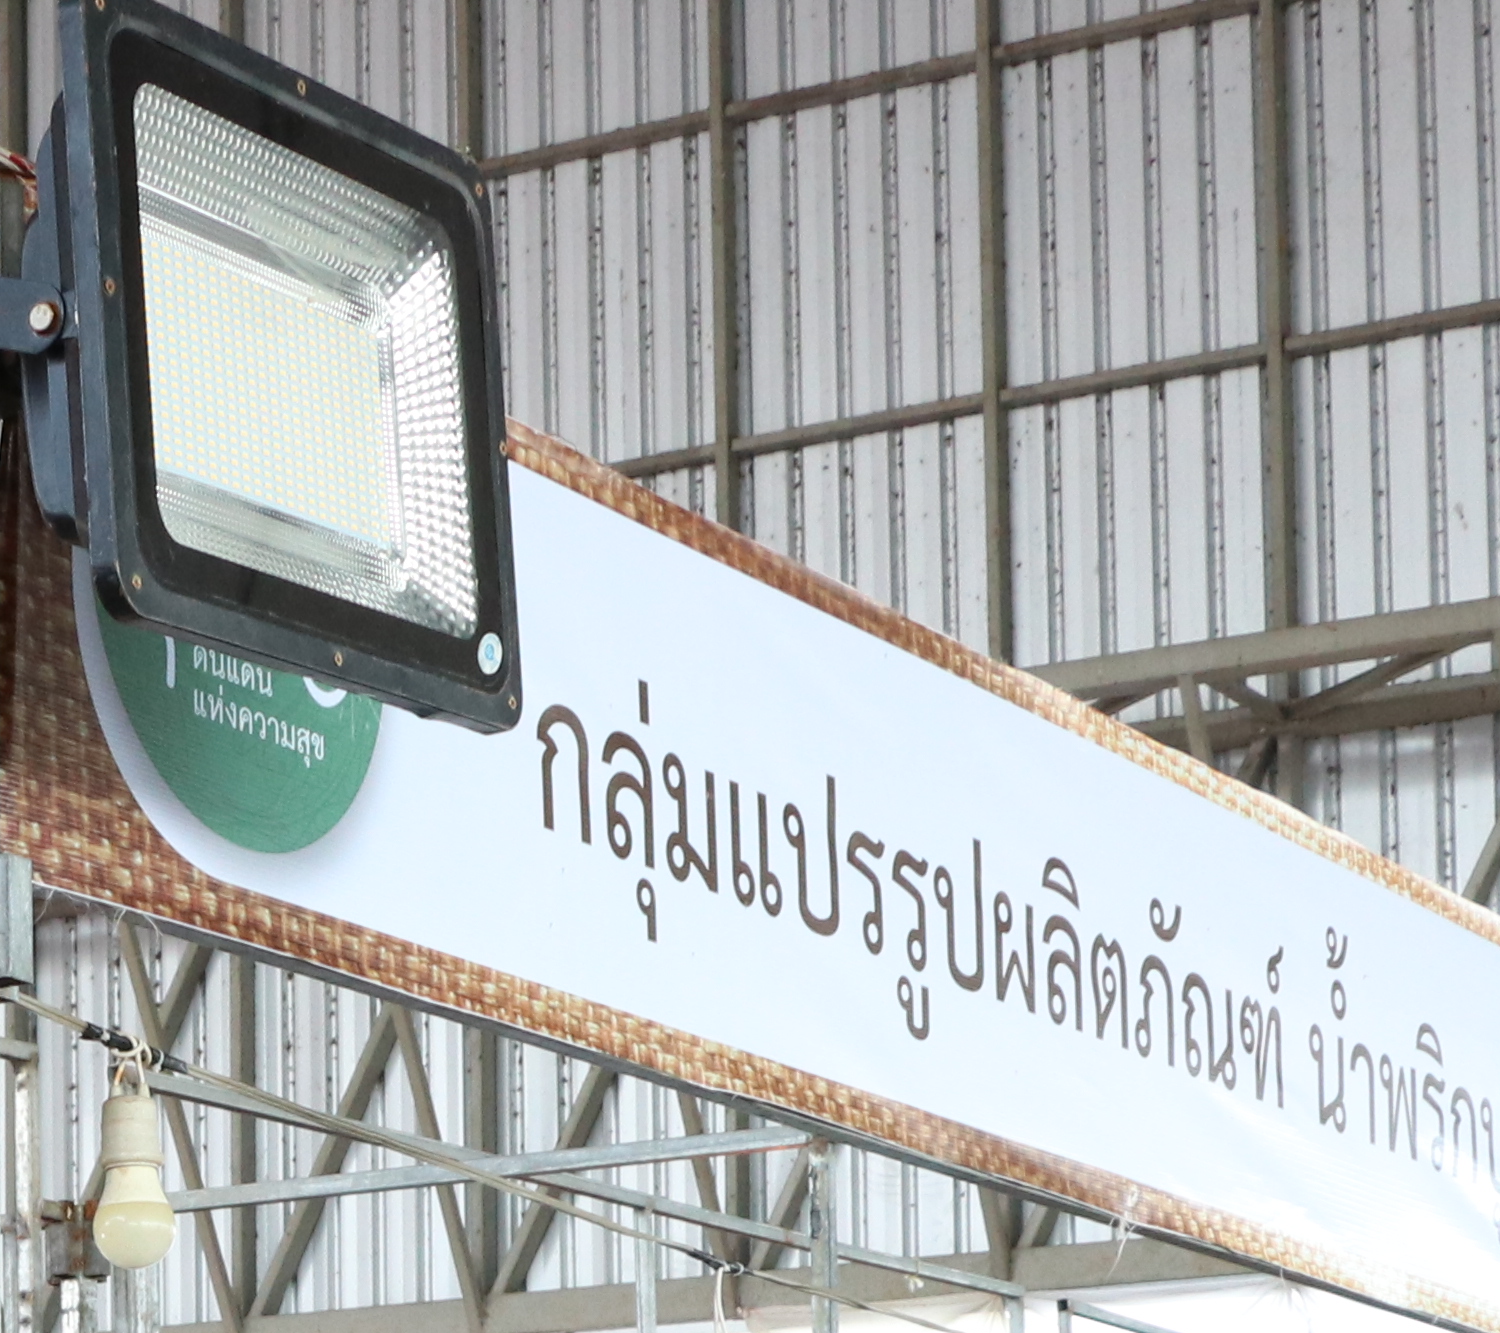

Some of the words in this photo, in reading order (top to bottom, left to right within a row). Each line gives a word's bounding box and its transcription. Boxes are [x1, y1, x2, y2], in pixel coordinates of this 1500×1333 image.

[192, 646, 274, 697] ดนแดน
[536, 679, 1284, 1111] กลุ่มแปรรูปผลิตภัณฑ์
